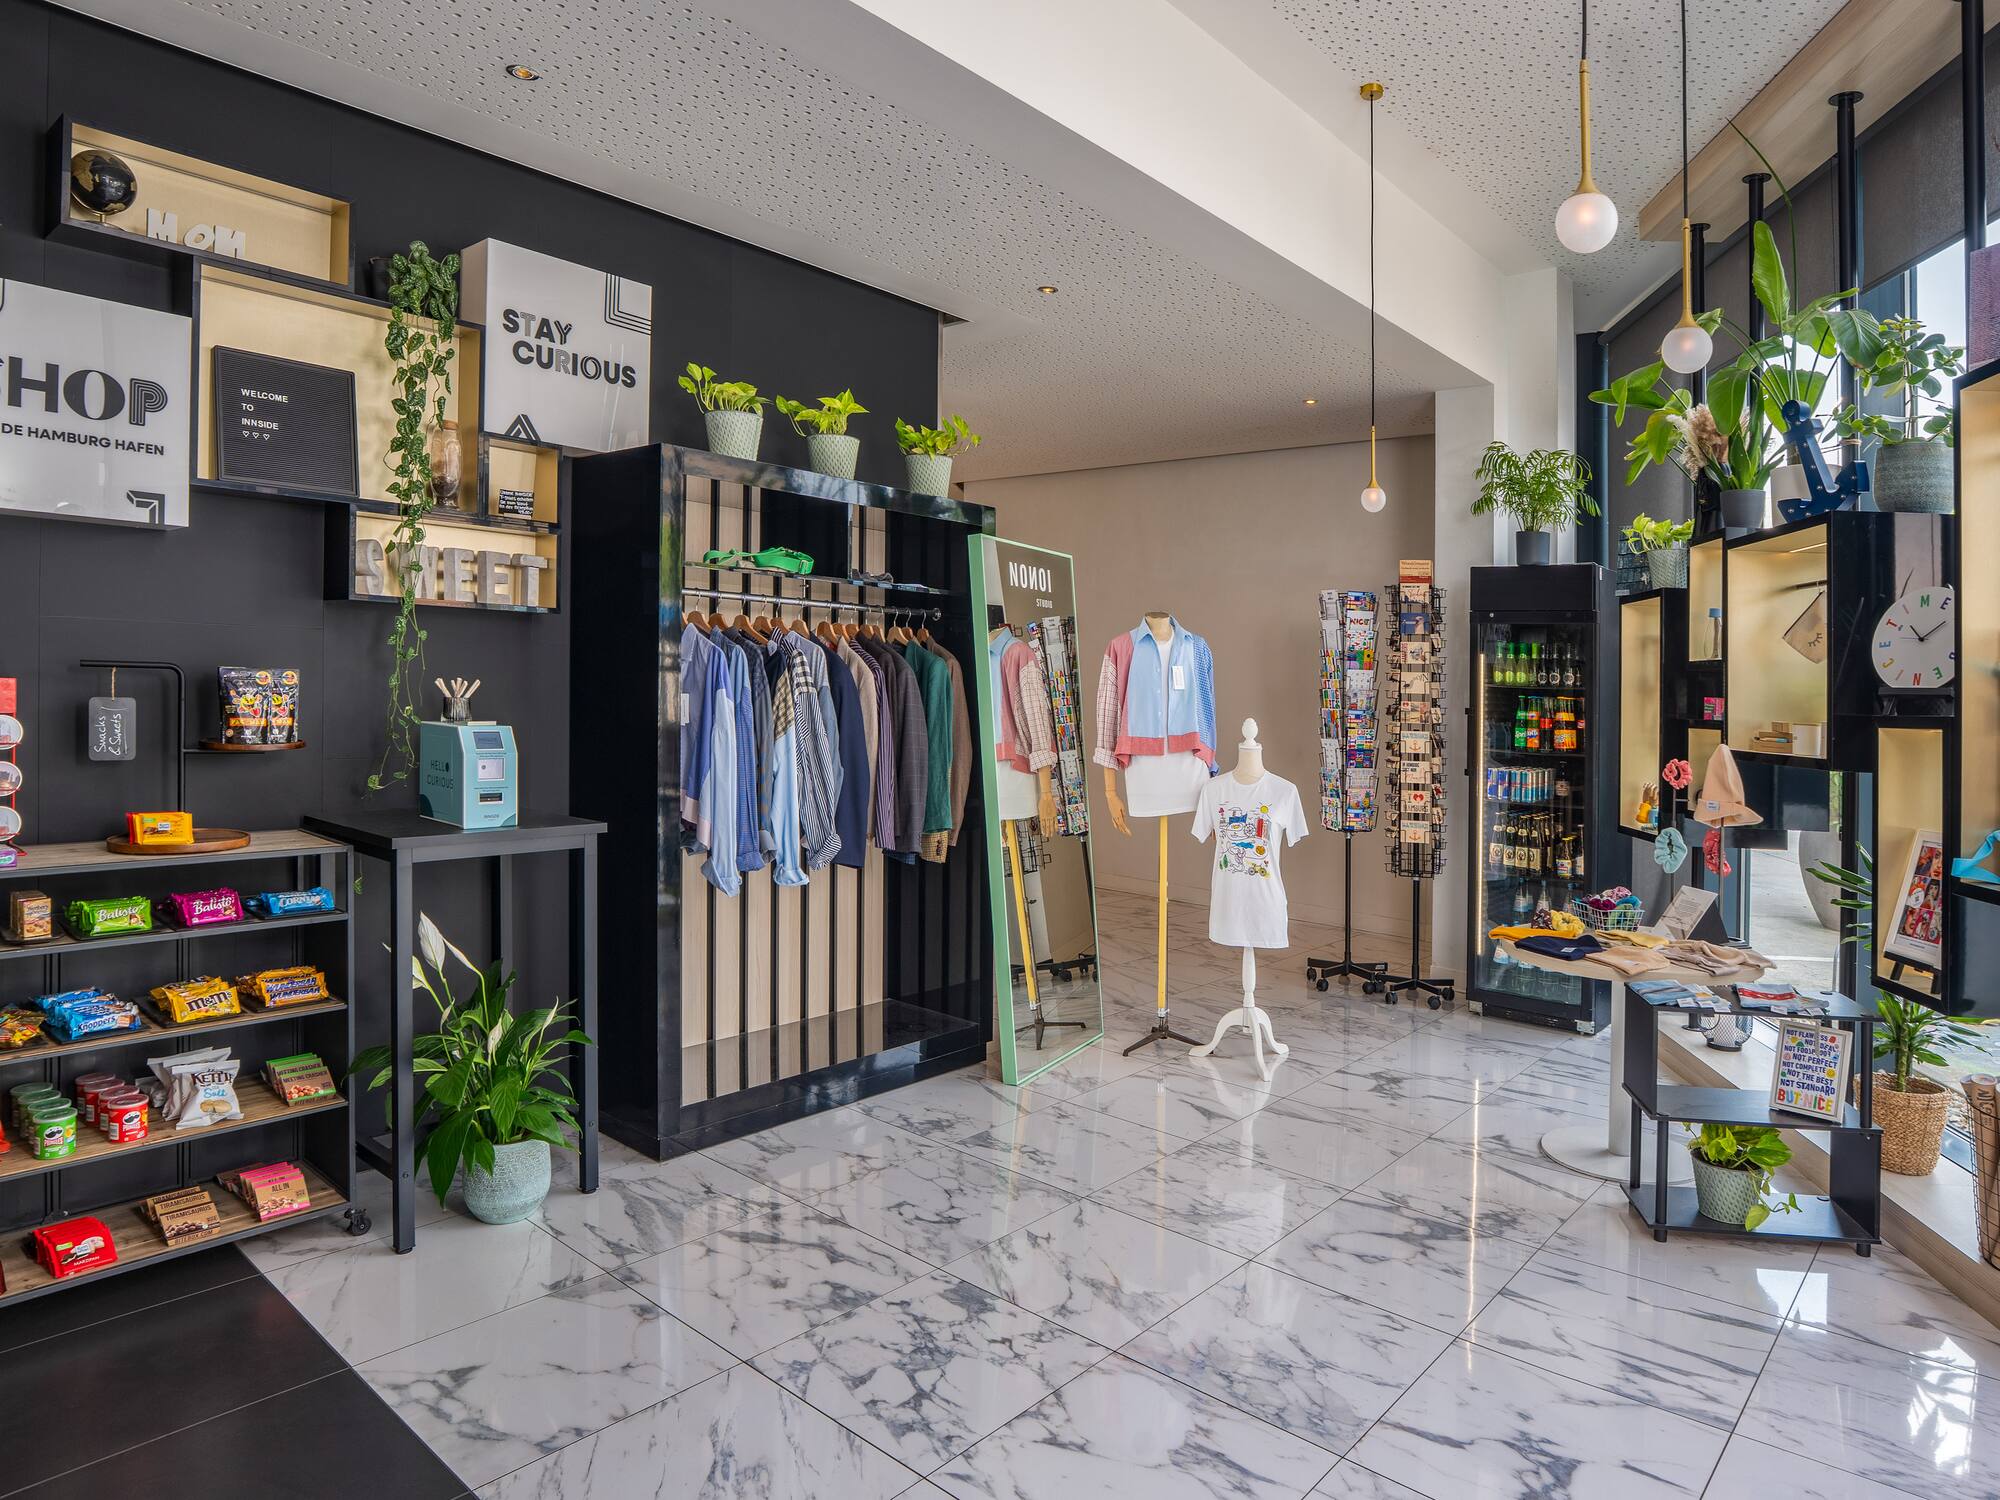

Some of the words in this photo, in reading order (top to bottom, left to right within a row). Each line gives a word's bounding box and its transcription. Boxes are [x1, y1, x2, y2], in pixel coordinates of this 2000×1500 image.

[503, 308, 573, 345] STAY
[512, 340, 636, 388] CURIOUS
[0, 355, 168, 426] HOP
[241, 388, 289, 403] WELCOME
[241, 403, 254, 412] TO
[241, 418, 279, 430] INNSIDE
[27, 426, 111, 448] HAMBURG
[114, 439, 165, 456] HAFEN
[355, 539, 548, 607] SWEET
[94, 716, 106, 752] Snacks
[109, 713, 122, 745] Sweets
[108, 746, 121, 756] &
[97, 905, 141, 922] Balisto
[193, 896, 233, 914] Balisto
[78, 1015, 116, 1032] Knoppers
[1818, 1043, 1836, 1052] DEAL
[1792, 1053, 1806, 1061] NOT
[1807, 1056, 1837, 1068] PERFECT
[1795, 1062, 1826, 1073] COMPLETE
[1787, 1069, 1800, 1077] NOT
[1802, 1072, 1815, 1081] THE
[1816, 1076, 1833, 1086] BEST
[203, 1088, 227, 1098] Salt
[1780, 1079, 1795, 1087] NOT
[1796, 1082, 1836, 1096] STANDARD
[1777, 1088, 1801, 1105] BUT
[1803, 1091, 1833, 1112] NICE
[271, 1184, 282, 1192] ALL
[282, 1182, 290, 1190] IN
[160, 1193, 206, 1210] TIRAMISAURUS
[165, 1204, 212, 1221] TIRAMISAURUS
